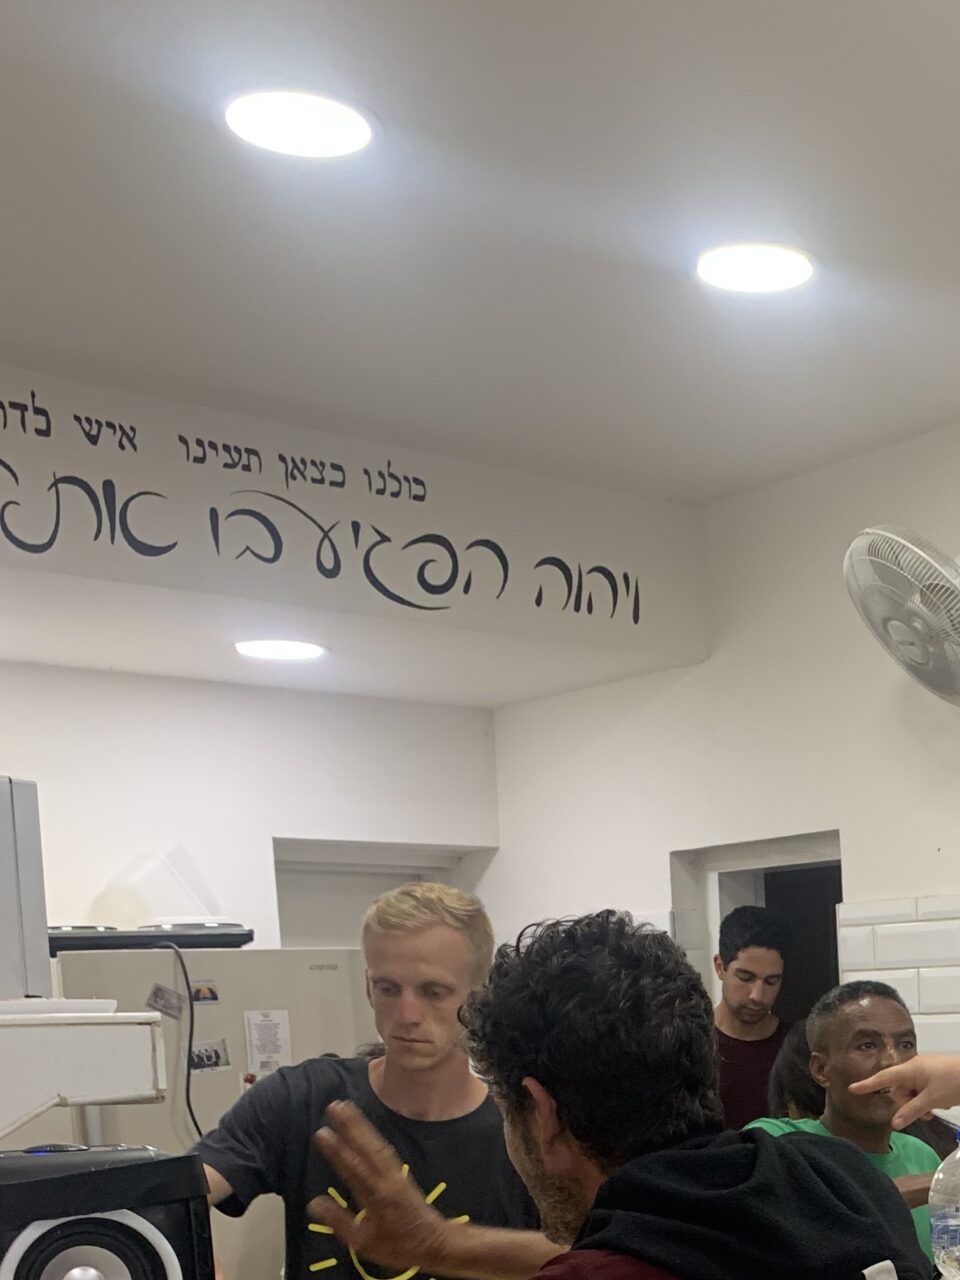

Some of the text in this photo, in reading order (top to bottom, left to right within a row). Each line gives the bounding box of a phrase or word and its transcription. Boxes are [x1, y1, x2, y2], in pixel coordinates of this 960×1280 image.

[73, 413, 138, 453] איש
[178, 434, 263, 474] תעינו
[278, 453, 346, 490] כצאן
[363, 459, 427, 503] כולנו
[208, 506, 284, 565] בו
[533, 556, 641, 625] ויהוה
